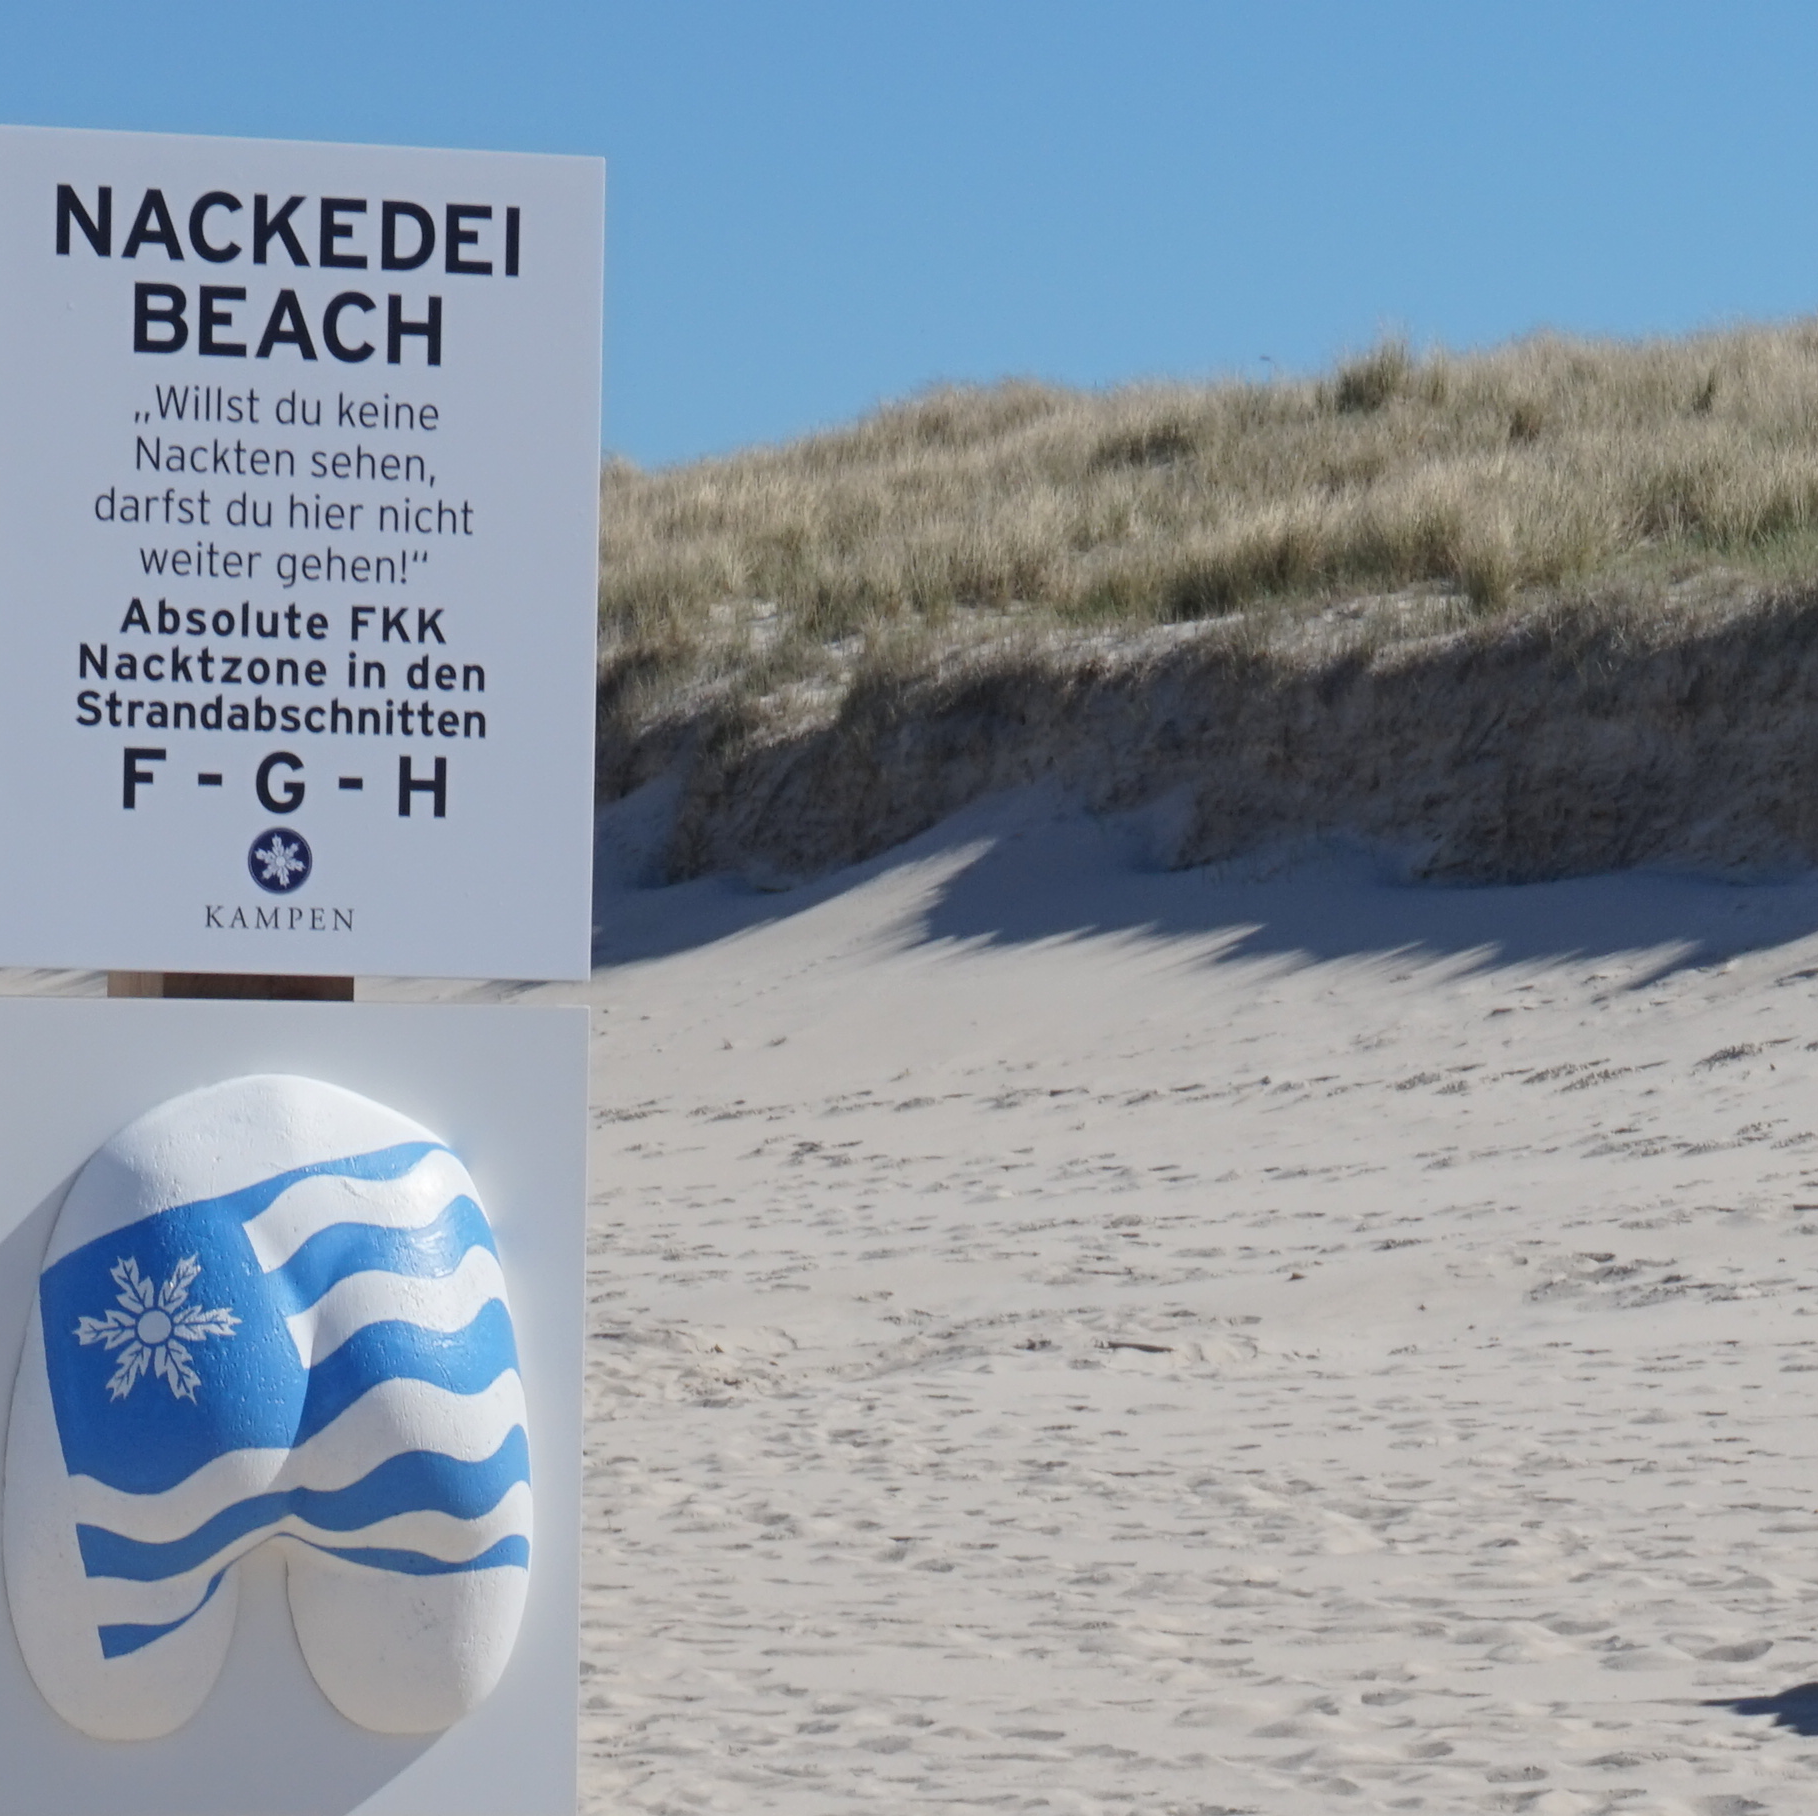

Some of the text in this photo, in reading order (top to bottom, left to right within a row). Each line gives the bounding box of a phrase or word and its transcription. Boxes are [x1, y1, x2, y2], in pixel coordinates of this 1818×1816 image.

[55, 183, 521, 278] NACKEDEI
[132, 280, 443, 368] BEACH
[275, 389, 322, 427] du
[338, 391, 439, 432] keine
[135, 435, 436, 489] Nackten sehen,
[94, 485, 474, 536] darfst du hier nicht
[139, 540, 262, 579] weiter
[119, 596, 447, 645] Absolute FKK
[79, 642, 486, 693] Nacktzone in den
[75, 689, 487, 740] Strandabschnitten
[204, 905, 355, 932] KAMPEN
